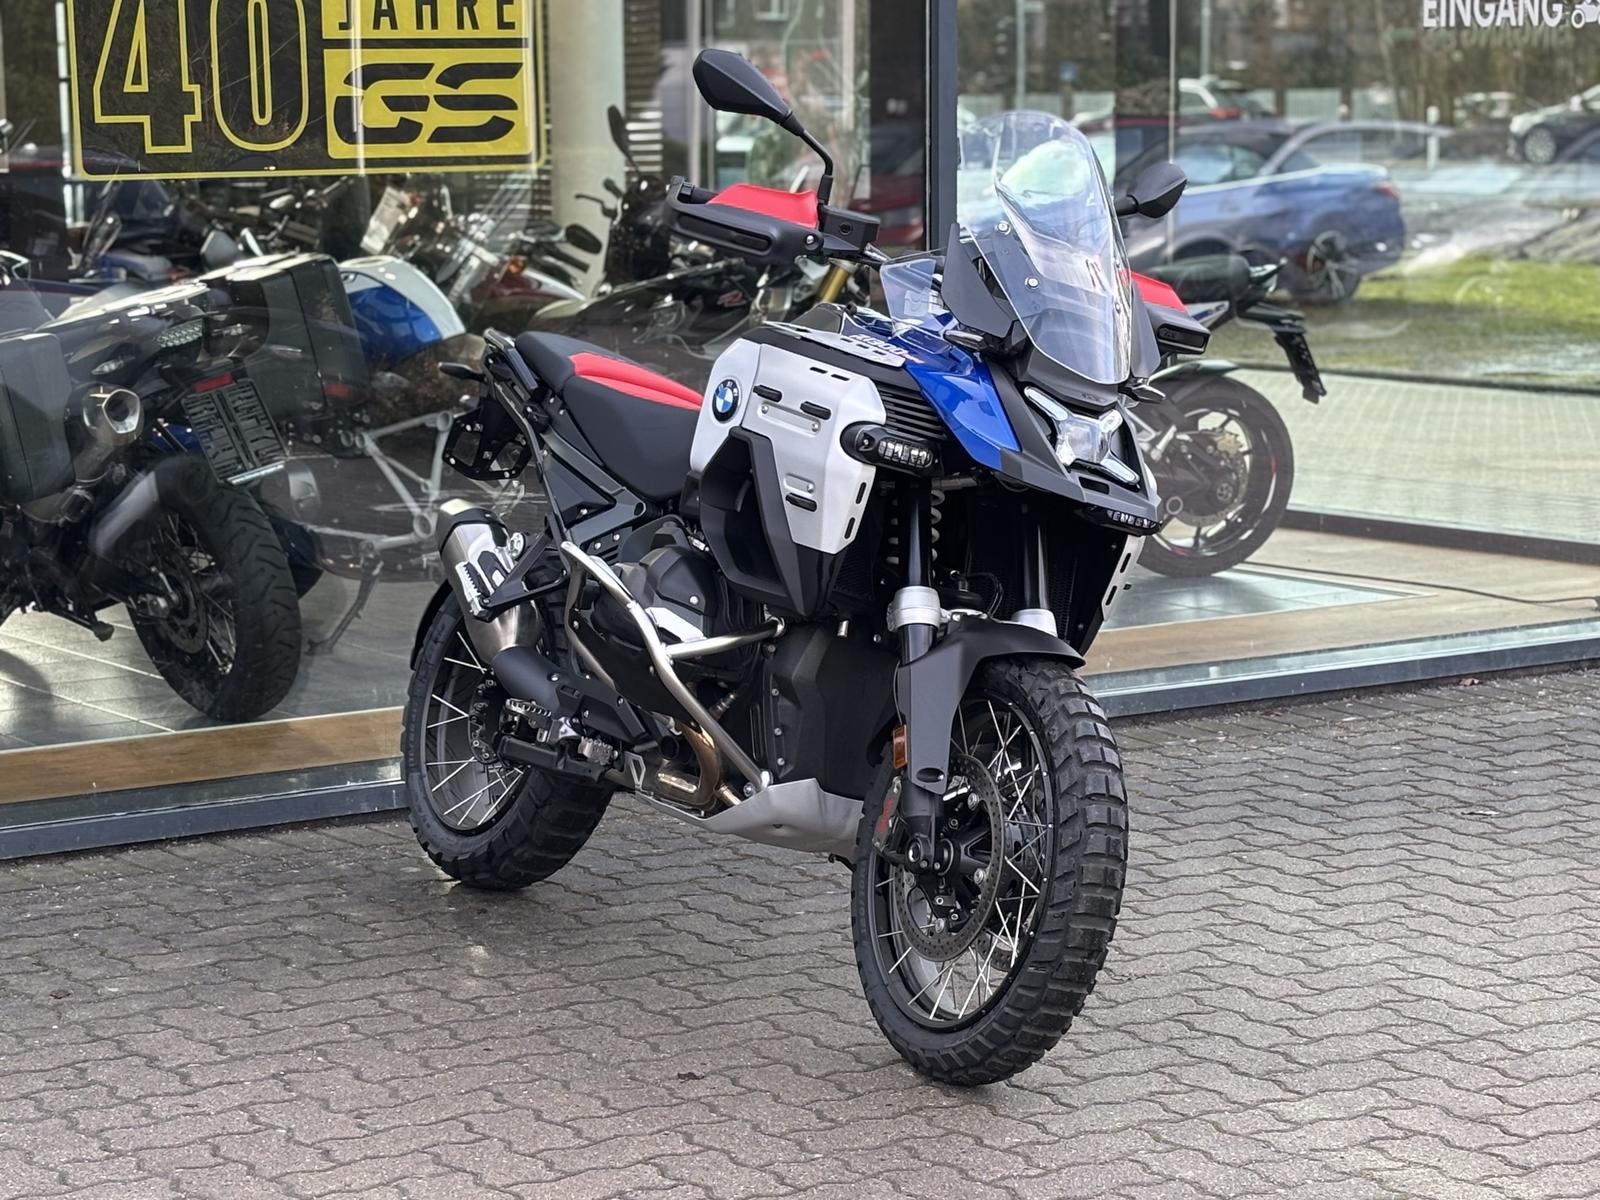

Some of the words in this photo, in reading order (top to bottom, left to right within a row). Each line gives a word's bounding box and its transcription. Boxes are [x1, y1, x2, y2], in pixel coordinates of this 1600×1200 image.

[338, 0, 516, 30] JAHRE
[1423, 0, 1563, 27] EINGANG
[93, 0, 309, 154] 40
[333, 62, 523, 145] GS
